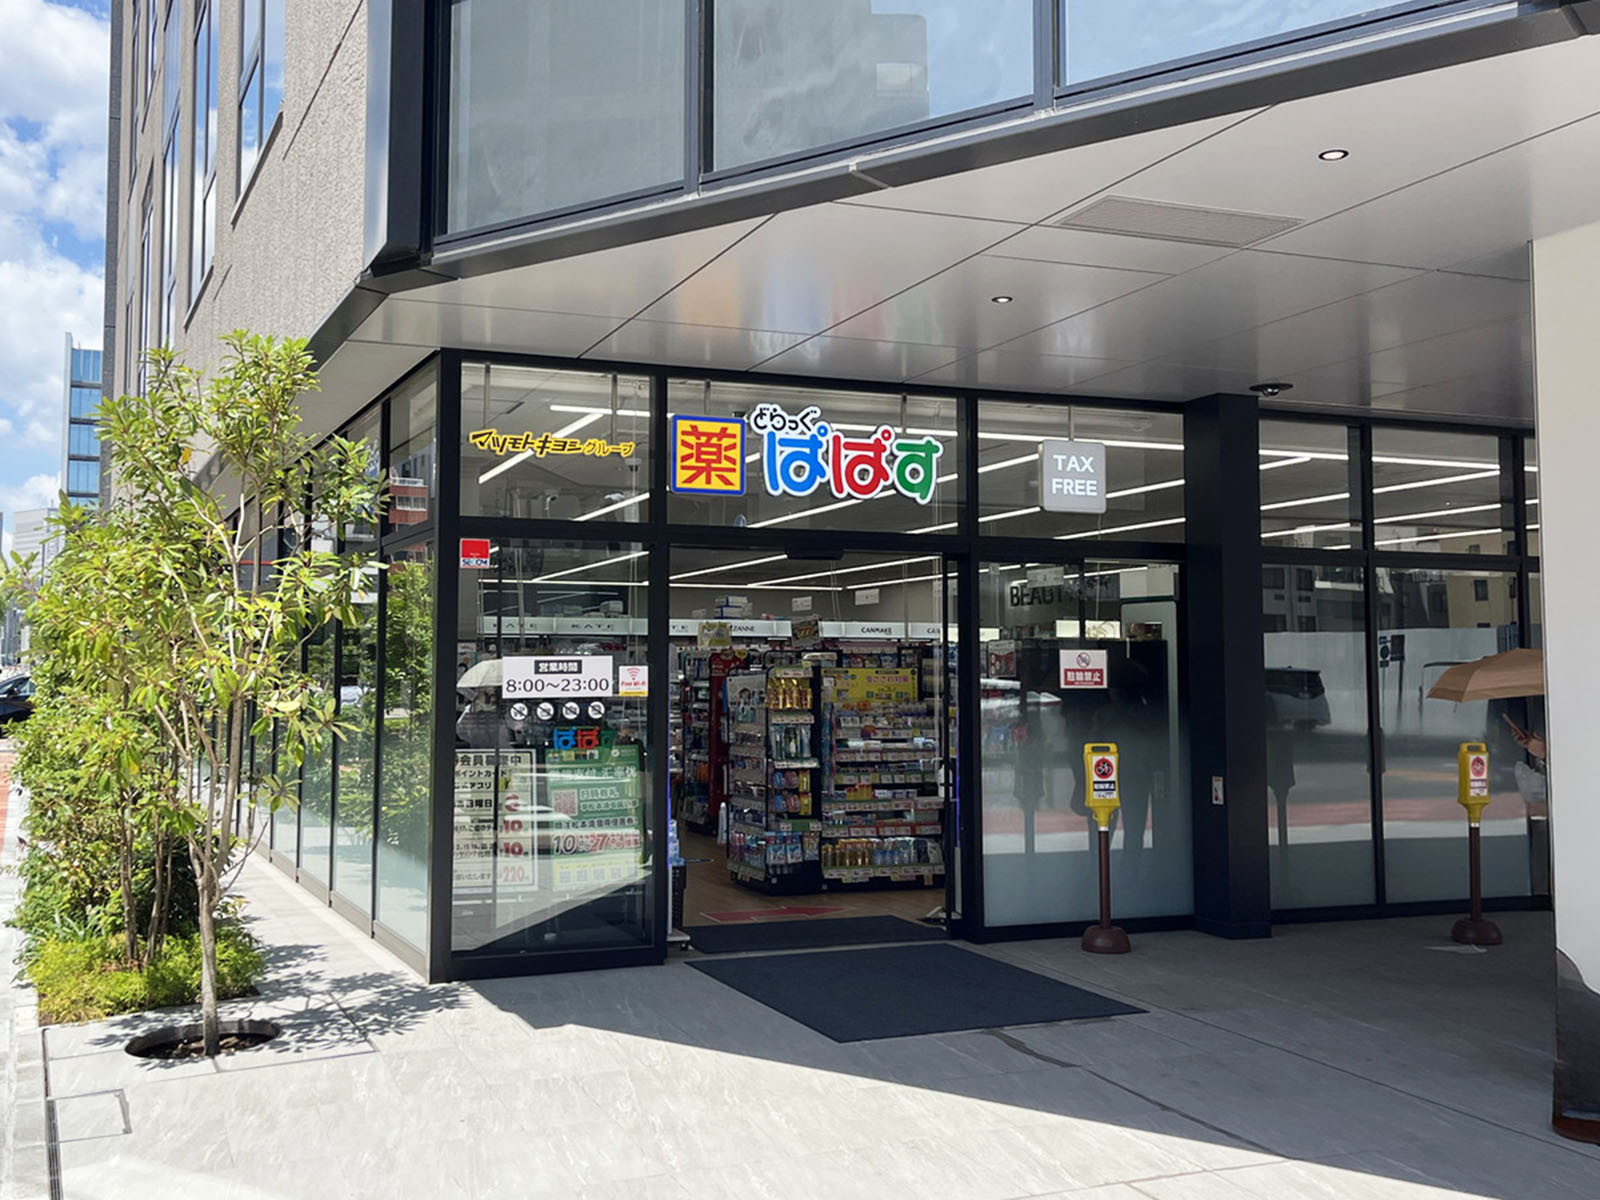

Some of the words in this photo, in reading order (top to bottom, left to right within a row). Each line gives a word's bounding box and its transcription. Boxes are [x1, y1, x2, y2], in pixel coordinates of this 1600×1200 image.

[753, 408, 817, 432] どらっぐ
[680, 424, 737, 486] 薬
[766, 425, 940, 500] ぱぱす
[1053, 454, 1095, 473] TAX
[1052, 478, 1098, 497] FREE
